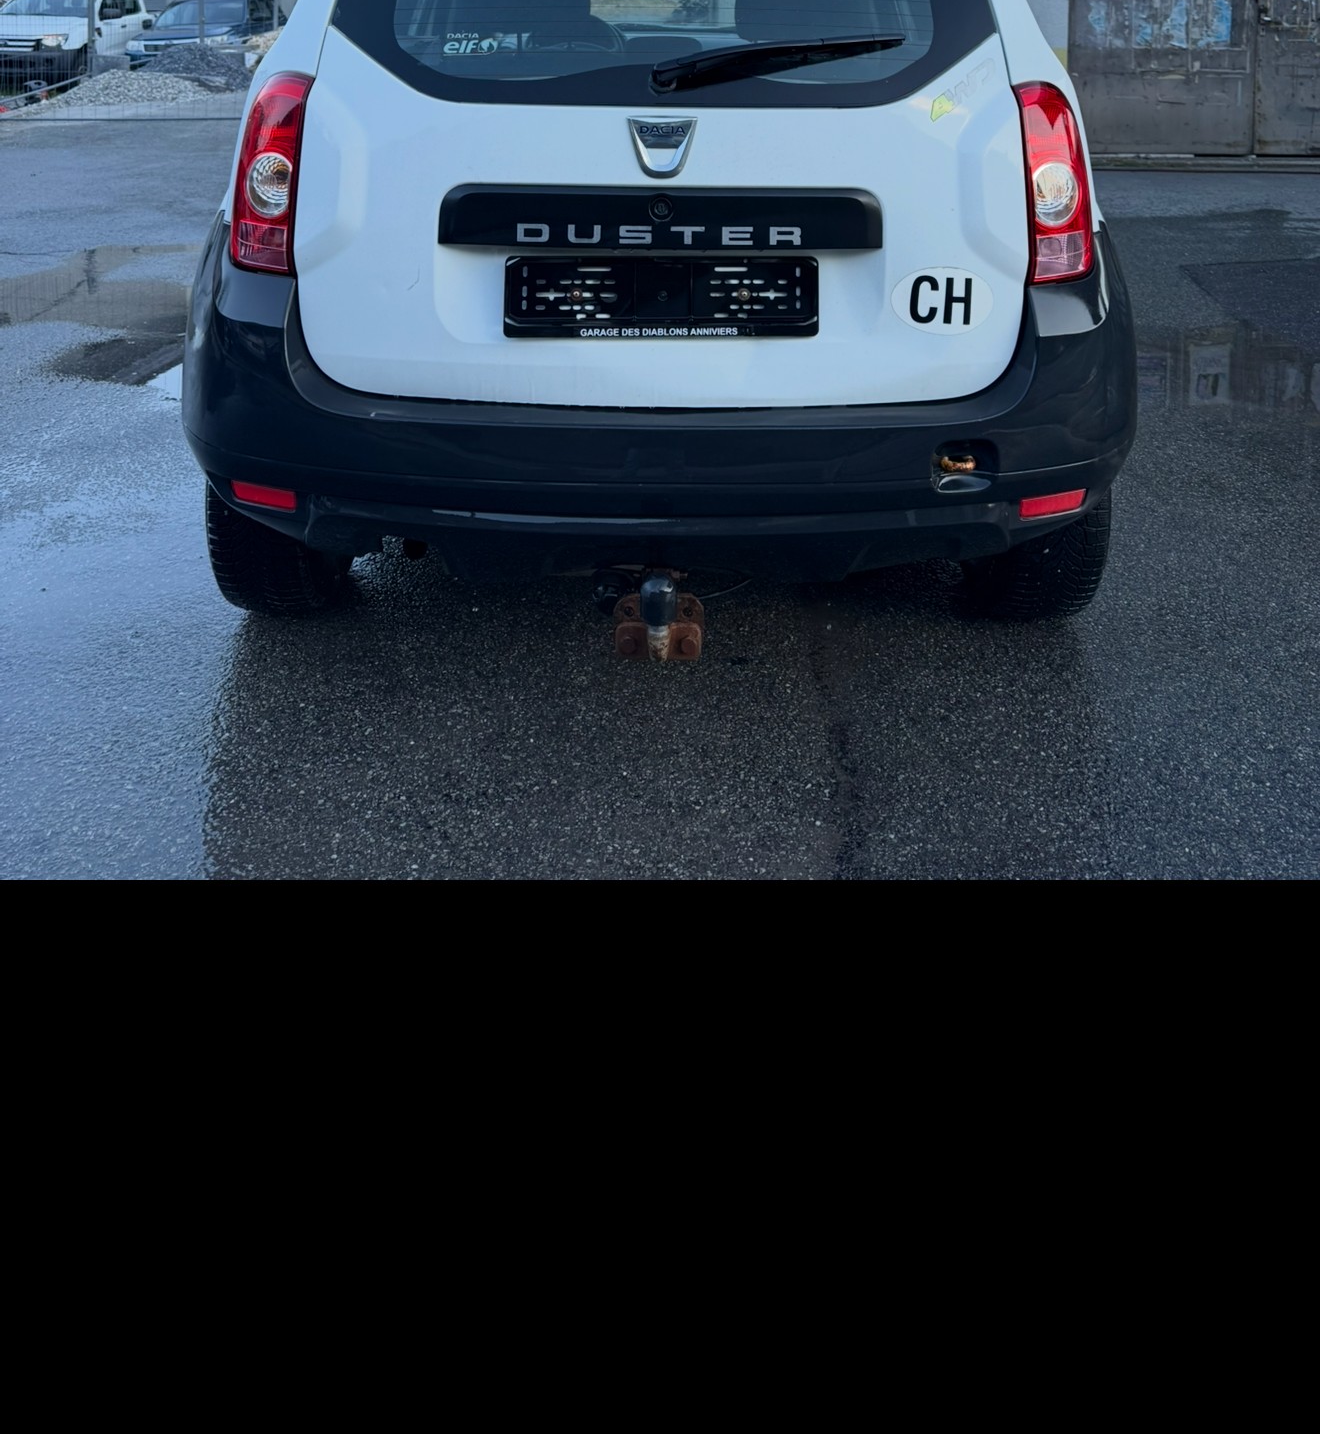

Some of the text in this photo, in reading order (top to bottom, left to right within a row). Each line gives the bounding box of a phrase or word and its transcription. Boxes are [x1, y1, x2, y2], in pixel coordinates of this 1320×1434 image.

[443, 40, 479, 54] elf
[640, 125, 686, 135] DACIA
[516, 223, 802, 246] DUSTER
[909, 274, 973, 326] CH
[580, 328, 620, 337] GARAGE
[621, 328, 640, 337] DES
[642, 327, 688, 336] DIABLONS
[690, 327, 738, 336] ANNIVIERS
